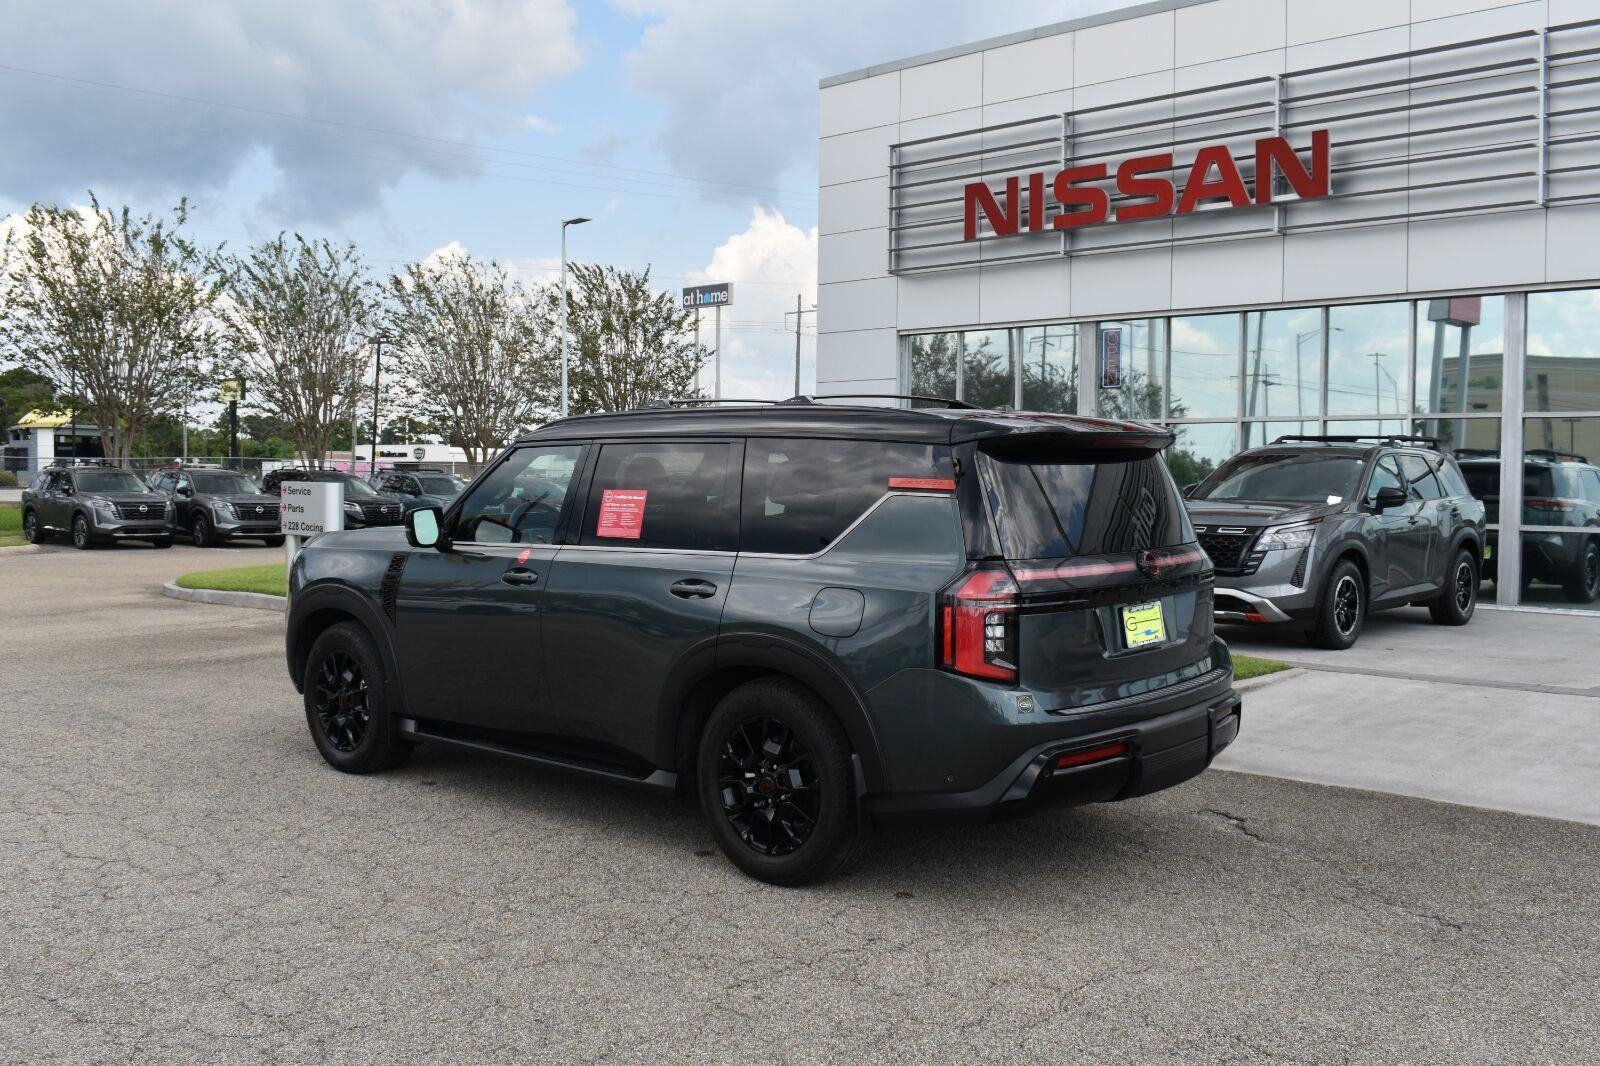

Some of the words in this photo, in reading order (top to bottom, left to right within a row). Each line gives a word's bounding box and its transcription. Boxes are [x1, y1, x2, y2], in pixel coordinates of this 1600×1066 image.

[964, 129, 1331, 241] NISSAN
[683, 292, 695, 306] at
[696, 289, 728, 304] home
[287, 486, 312, 496] Service
[287, 503, 305, 513] Parts
[288, 521, 299, 531] 228
[300, 522, 324, 533] Cocina
